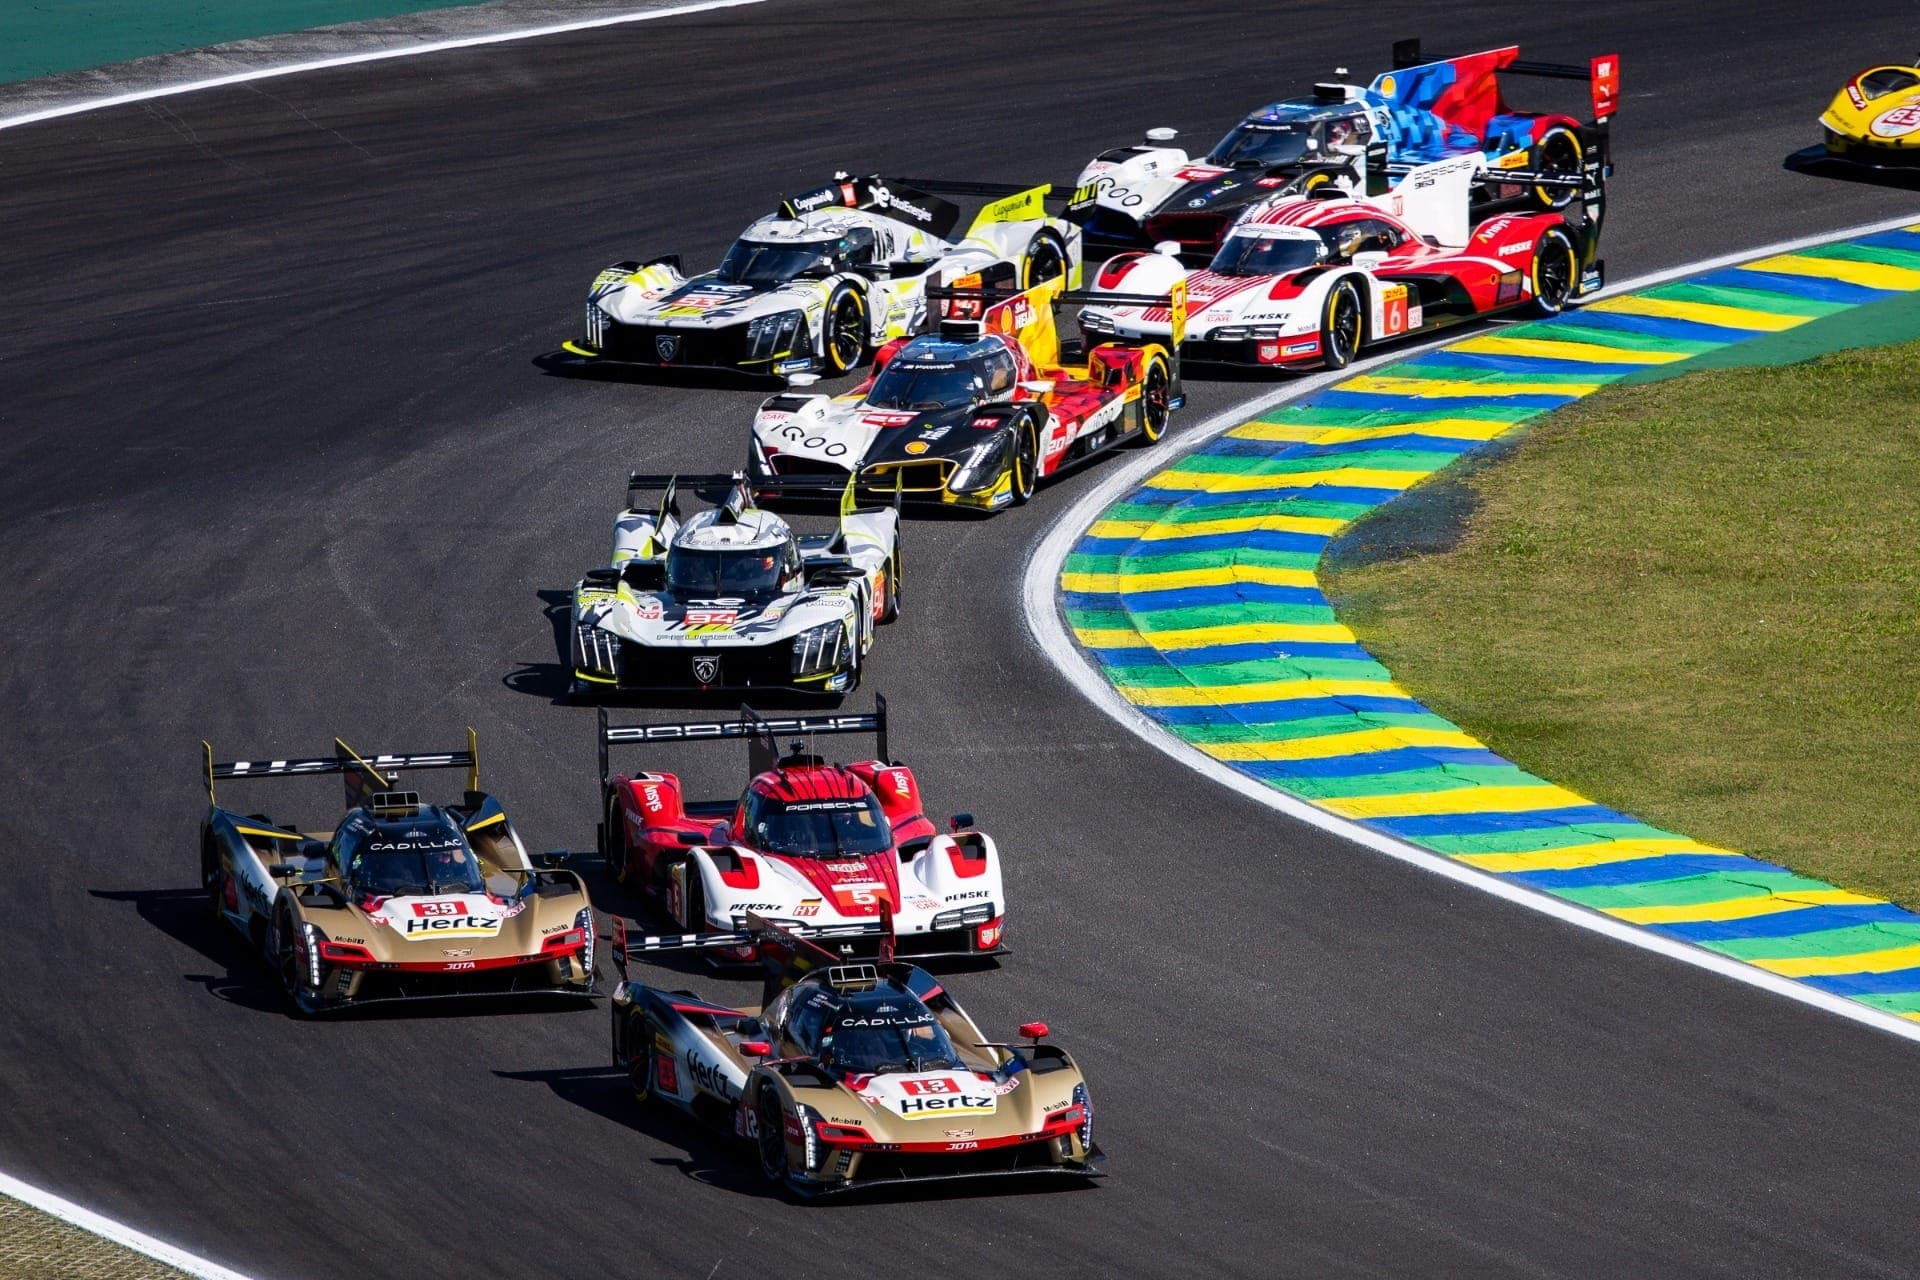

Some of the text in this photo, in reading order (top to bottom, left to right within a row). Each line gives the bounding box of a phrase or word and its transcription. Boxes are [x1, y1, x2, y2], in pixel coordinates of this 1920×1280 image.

[1414, 160, 1472, 180] PORSCHE
[889, 195, 933, 222] TotalEnergies
[993, 199, 1025, 219] Capgemini
[1498, 240, 1533, 257] PENSKE
[1242, 312, 1293, 321] PENSKE
[1390, 300, 1402, 331] 6
[687, 613, 735, 623] 94
[785, 802, 868, 812] PORSCHE
[370, 838, 463, 851] CADILLAC
[851, 889, 877, 905] 5
[944, 890, 991, 903] PENSKE
[729, 903, 785, 912] PENSKE
[793, 906, 820, 917] HY
[406, 915, 499, 933] Hertz
[442, 962, 476, 971] JOTA
[842, 1013, 935, 1028] CADILLAC
[687, 1048, 728, 1097] Hertz
[900, 1095, 994, 1114] Hertz
[945, 1141, 978, 1151] JOTA
